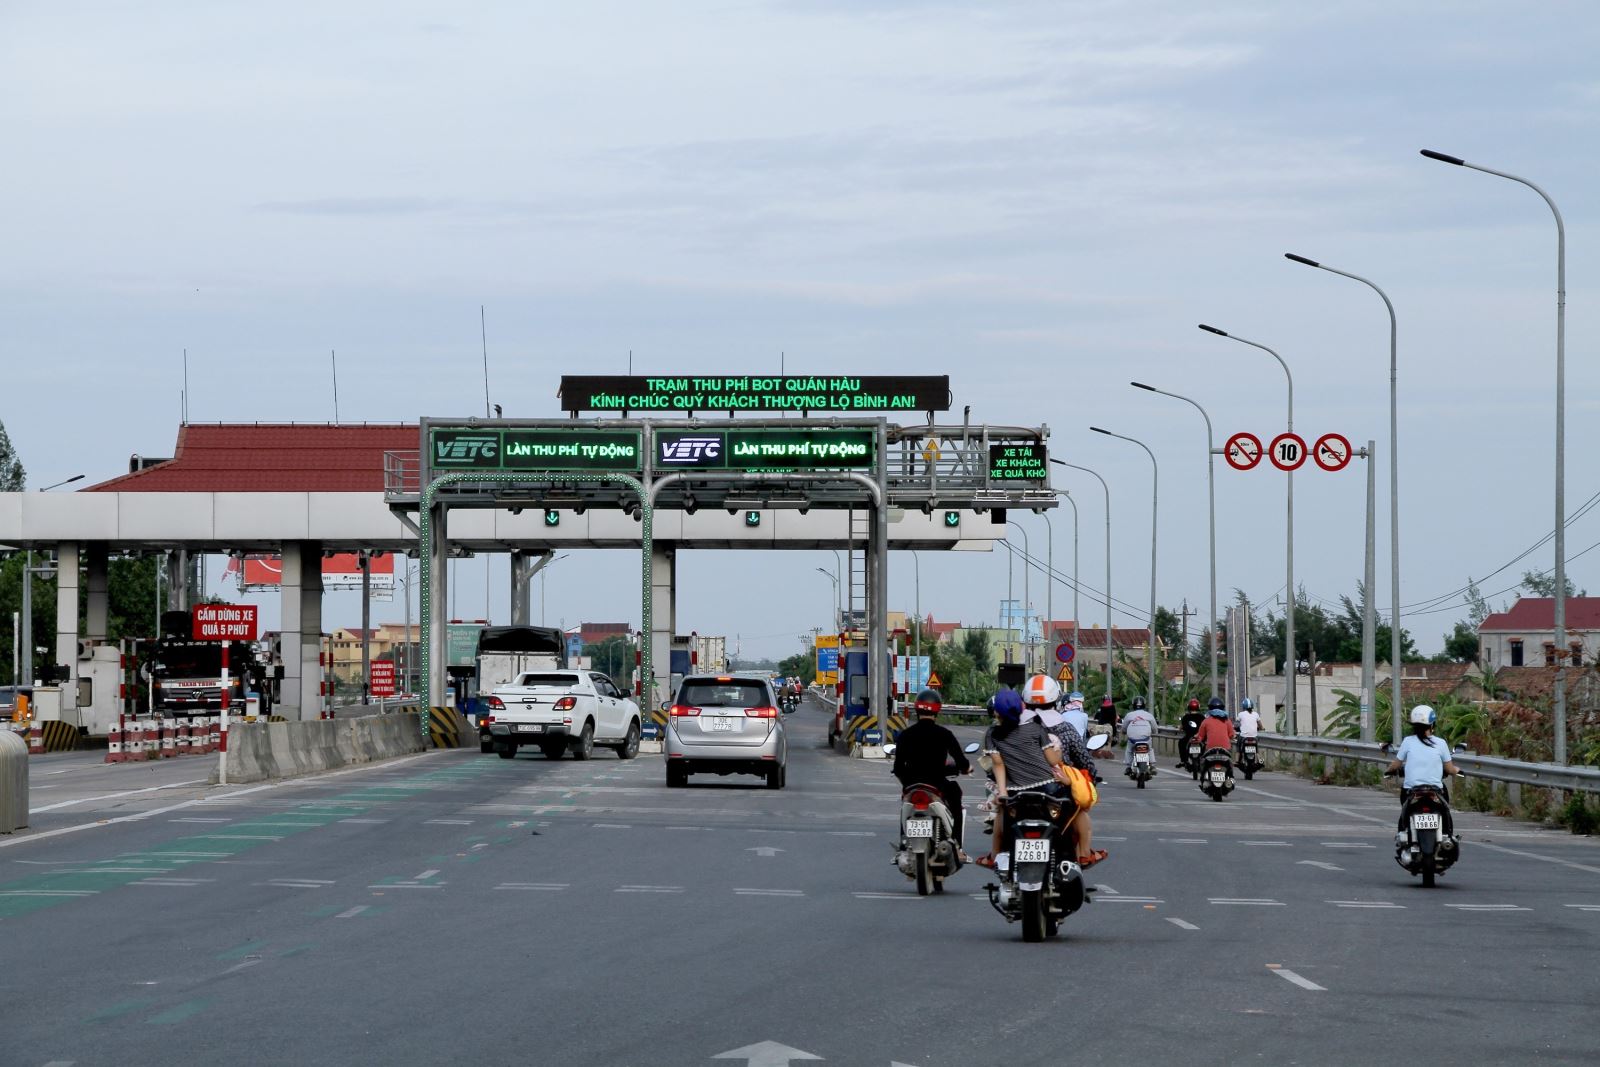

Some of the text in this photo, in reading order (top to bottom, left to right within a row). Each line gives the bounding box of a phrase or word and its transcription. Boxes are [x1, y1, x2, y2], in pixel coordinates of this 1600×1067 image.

[647, 376, 860, 394] TRẠM THU PHÍ BOT QUÁN HÀU
[590, 392, 916, 411] KÍNH CHÚC QUÝ KHÁCH THƯỢNG LỘ BÌNH AN!
[437, 441, 498, 458] VETC
[506, 442, 635, 459] LÀN THU PHÍ TỰ ĐỘNG
[662, 442, 721, 458] VETC
[734, 441, 867, 458] LÀN THU PHÍ TỰ ĐỘNG
[1004, 448, 1016, 457] XE
[1279, 443, 1298, 461] 10
[995, 457, 1041, 467] XE KHÁCH
[990, 469, 1003, 478] XE
[1004, 467, 1025, 478] QUÁ
[198, 606, 254, 621] CẤM DỪNG XE
[202, 621, 251, 637] QUÁ 5 PHÚT
[1021, 840, 1044, 850] 73-G1
[1017, 850, 1047, 861] 226.81
